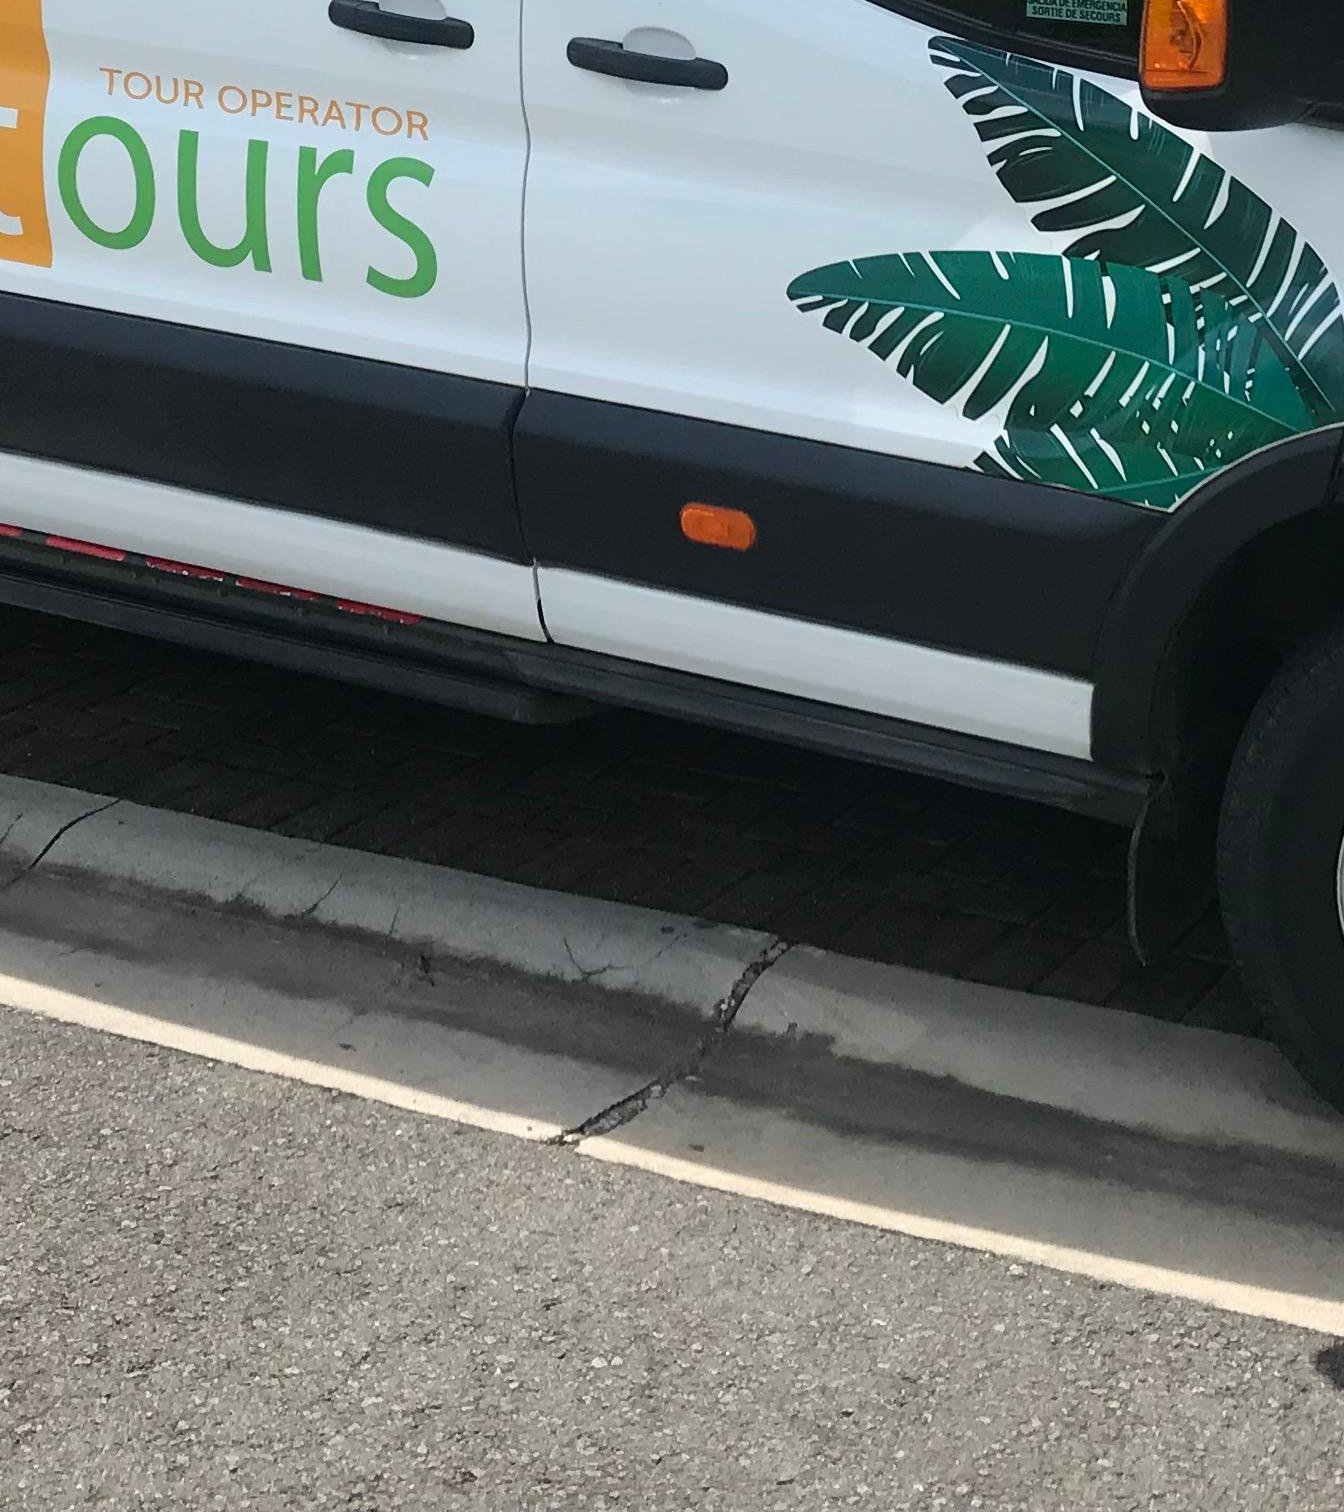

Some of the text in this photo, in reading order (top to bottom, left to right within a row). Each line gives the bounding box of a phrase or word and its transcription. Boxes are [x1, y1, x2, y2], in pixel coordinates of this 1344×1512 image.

[1032, 5, 1121, 23] SORTIE DE SECOURS
[1072, 0, 1127, 12] EMERGENCIA
[99, 66, 430, 141] TOUR OPERATOR
